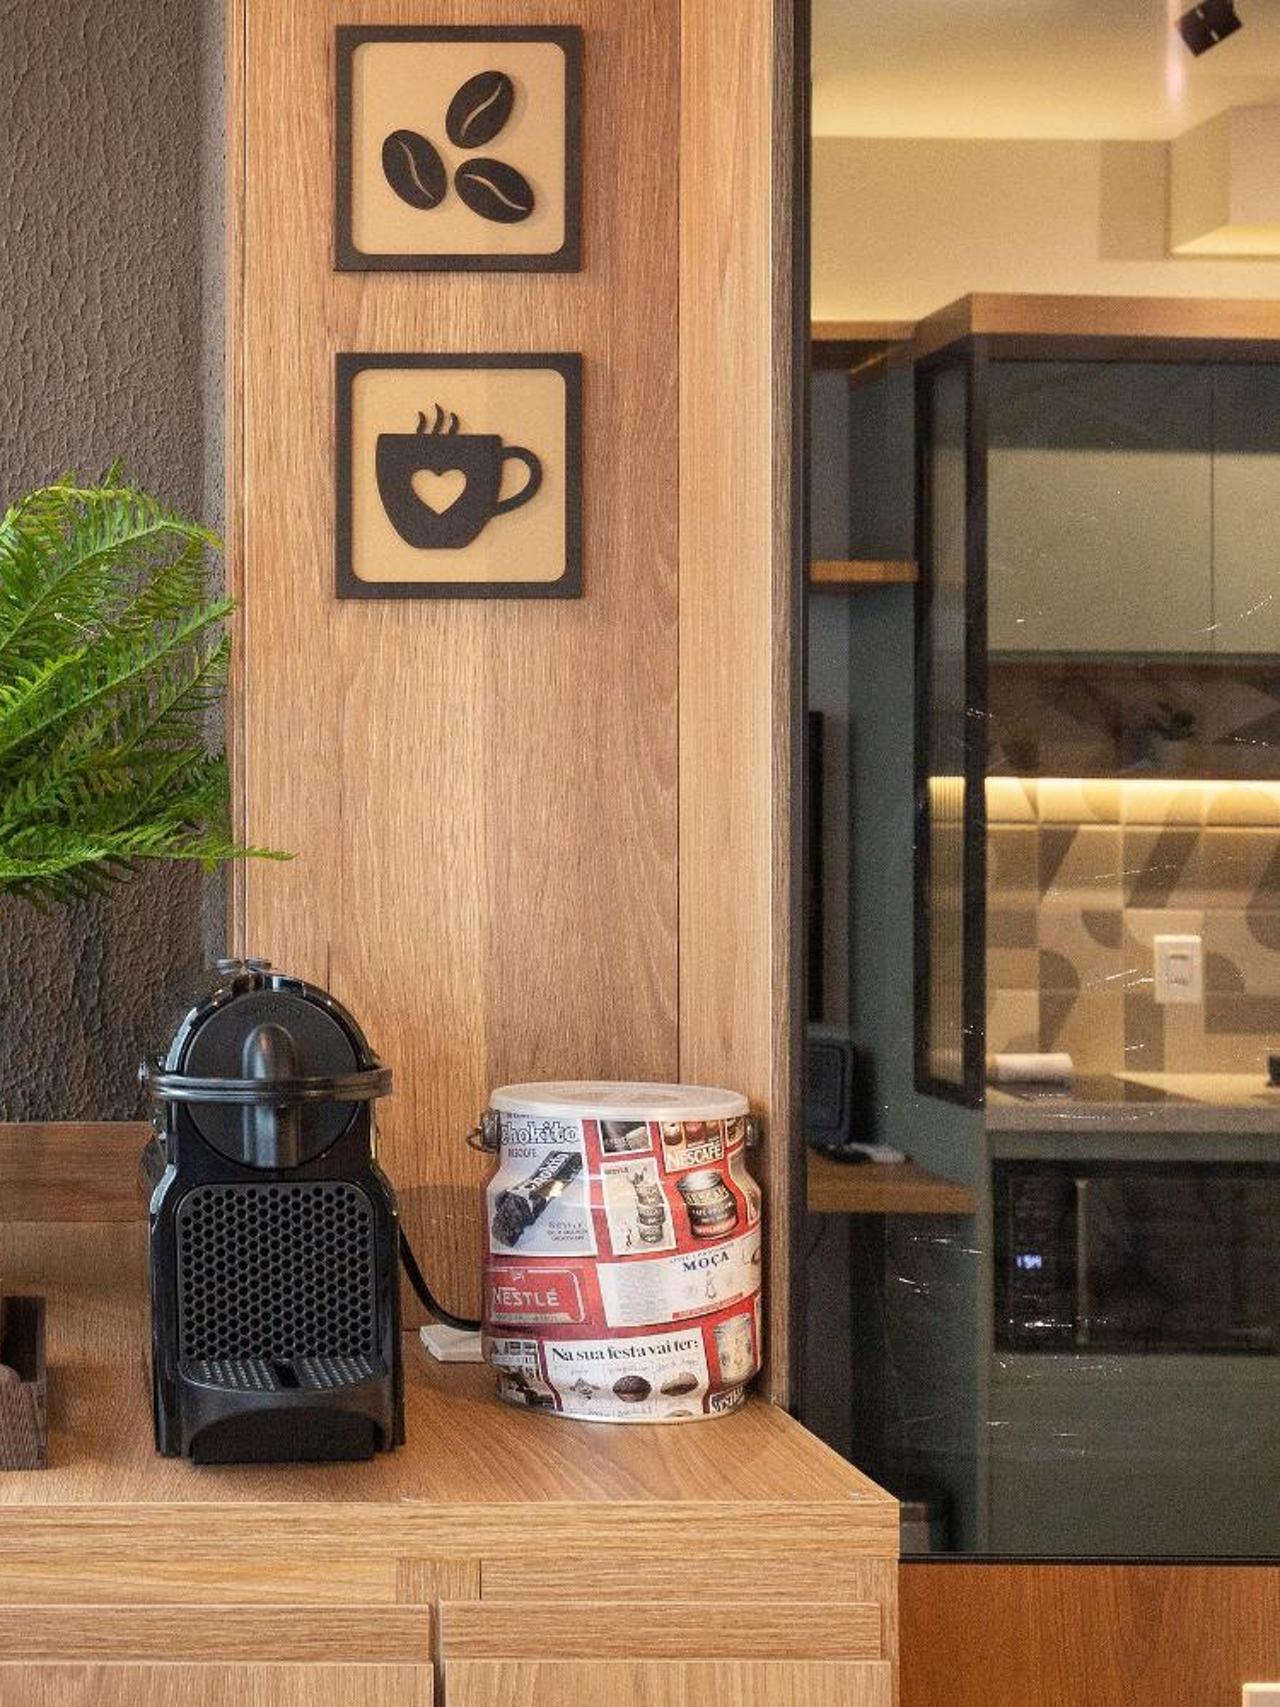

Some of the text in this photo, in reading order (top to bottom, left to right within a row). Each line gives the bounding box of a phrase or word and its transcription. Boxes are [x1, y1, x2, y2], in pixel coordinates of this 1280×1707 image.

[682, 1251, 729, 1272] MOÇA
[493, 1287, 560, 1306] NESTLÉ
[552, 1348, 573, 1361] Na
[576, 1350, 605, 1360] sua
[607, 1345, 646, 1360] festa
[646, 1340, 671, 1355] vai
